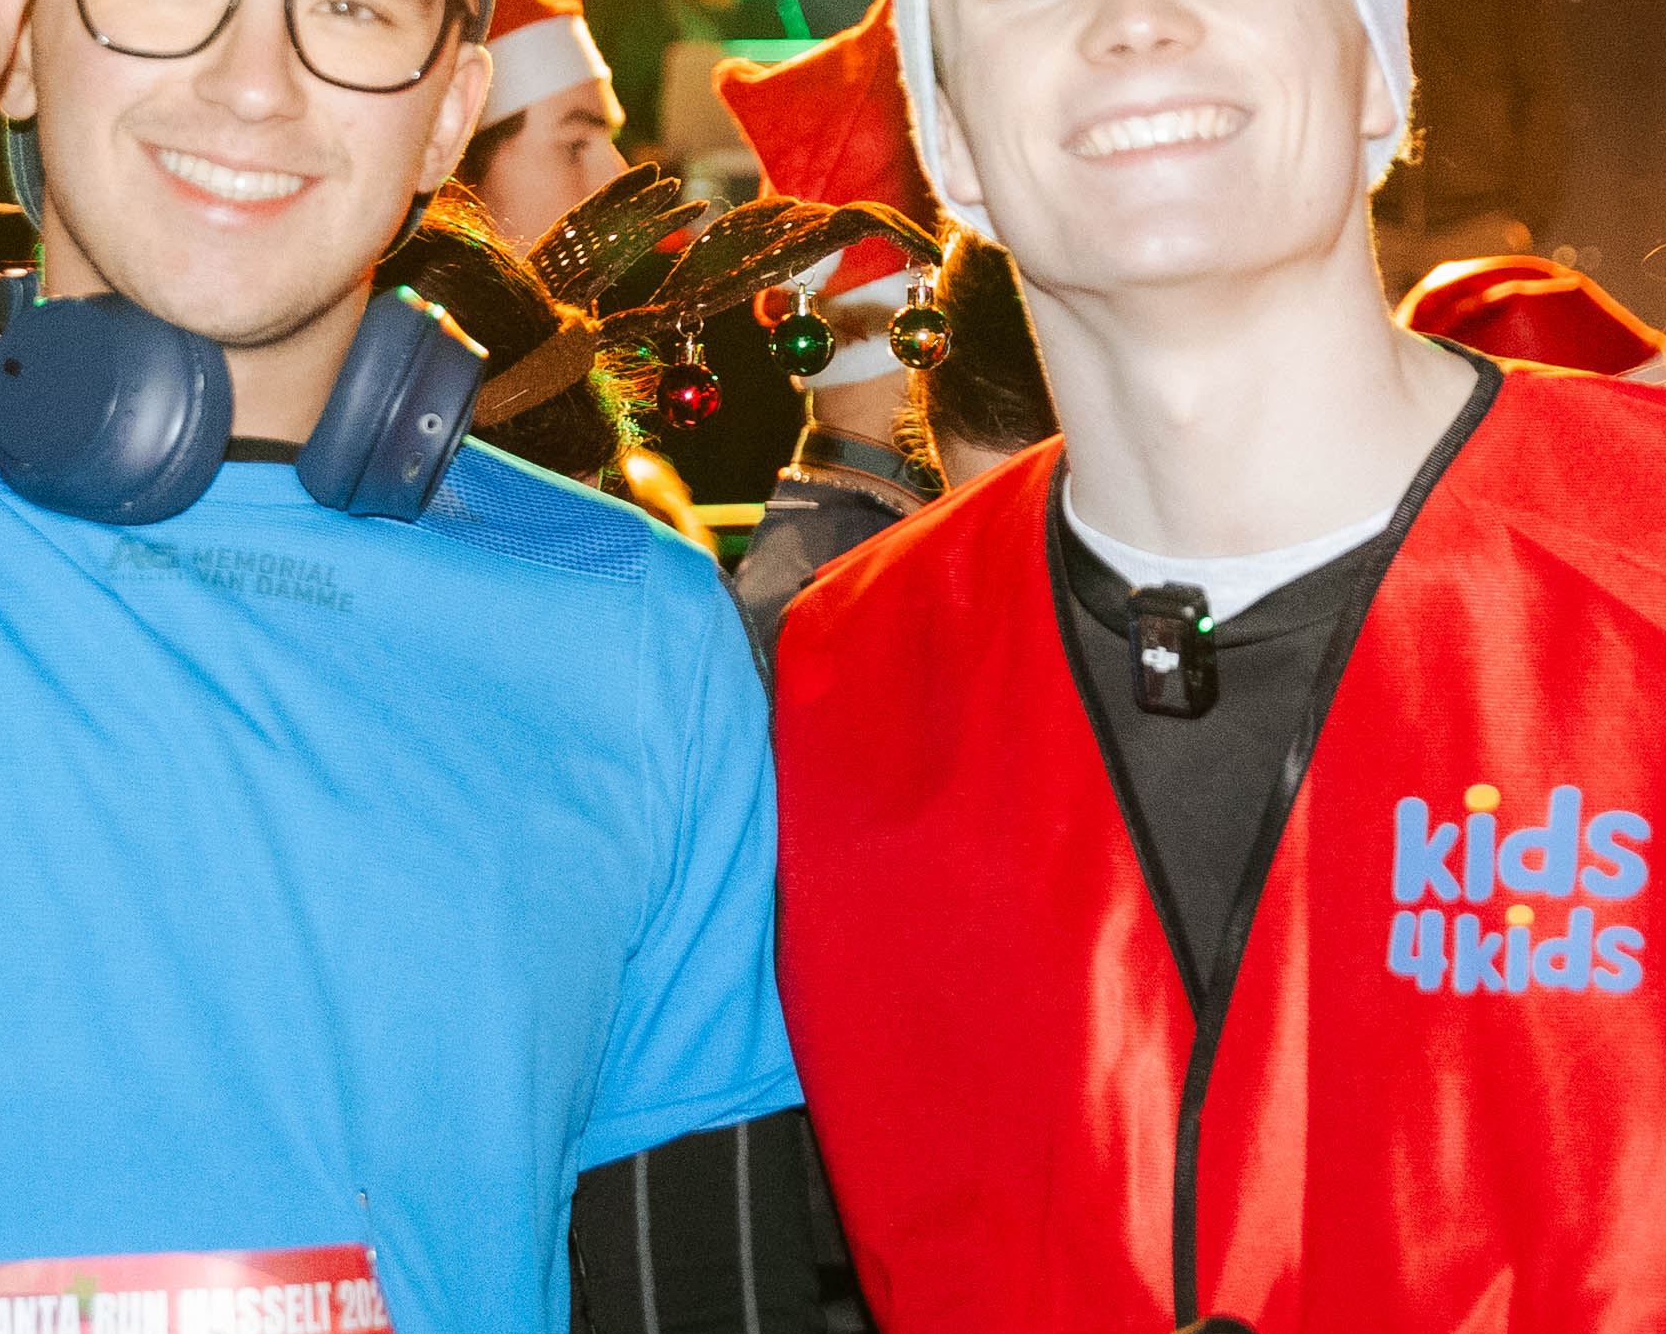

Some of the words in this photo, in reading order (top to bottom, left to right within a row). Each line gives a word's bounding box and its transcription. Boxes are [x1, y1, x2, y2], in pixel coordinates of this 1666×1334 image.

[191, 546, 337, 588] MEMORIAL
[196, 567, 245, 595] VAN
[256, 574, 354, 612] DAMME
[1393, 783, 1652, 903] kids
[1388, 904, 1646, 994] 4kids
